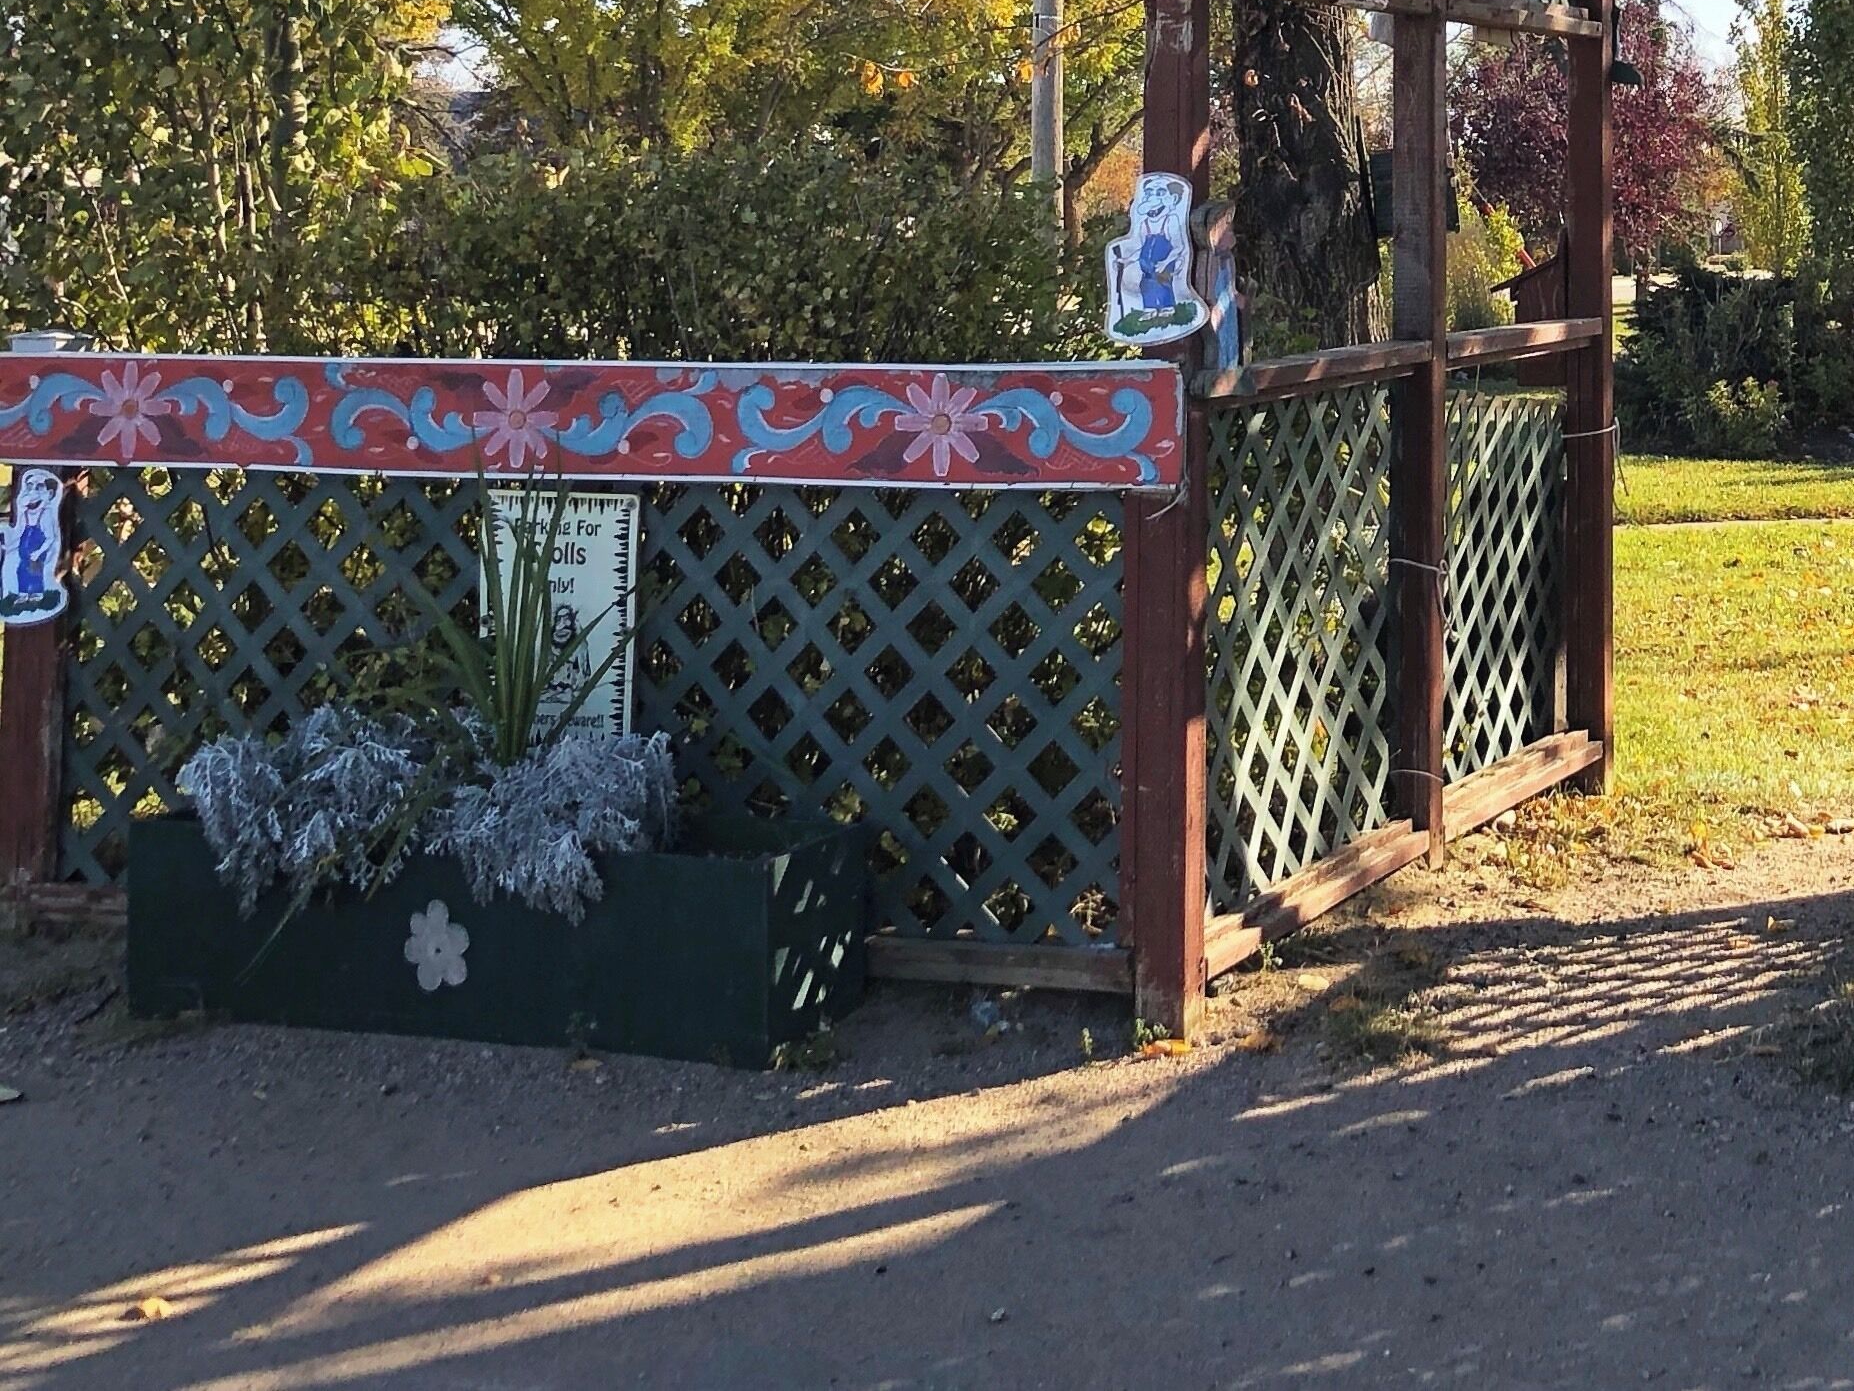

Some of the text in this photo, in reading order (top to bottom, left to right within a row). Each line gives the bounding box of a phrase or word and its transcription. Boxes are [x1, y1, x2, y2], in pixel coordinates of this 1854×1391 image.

[514, 517, 602, 537] Prkg For
[547, 576, 575, 594] nly!
